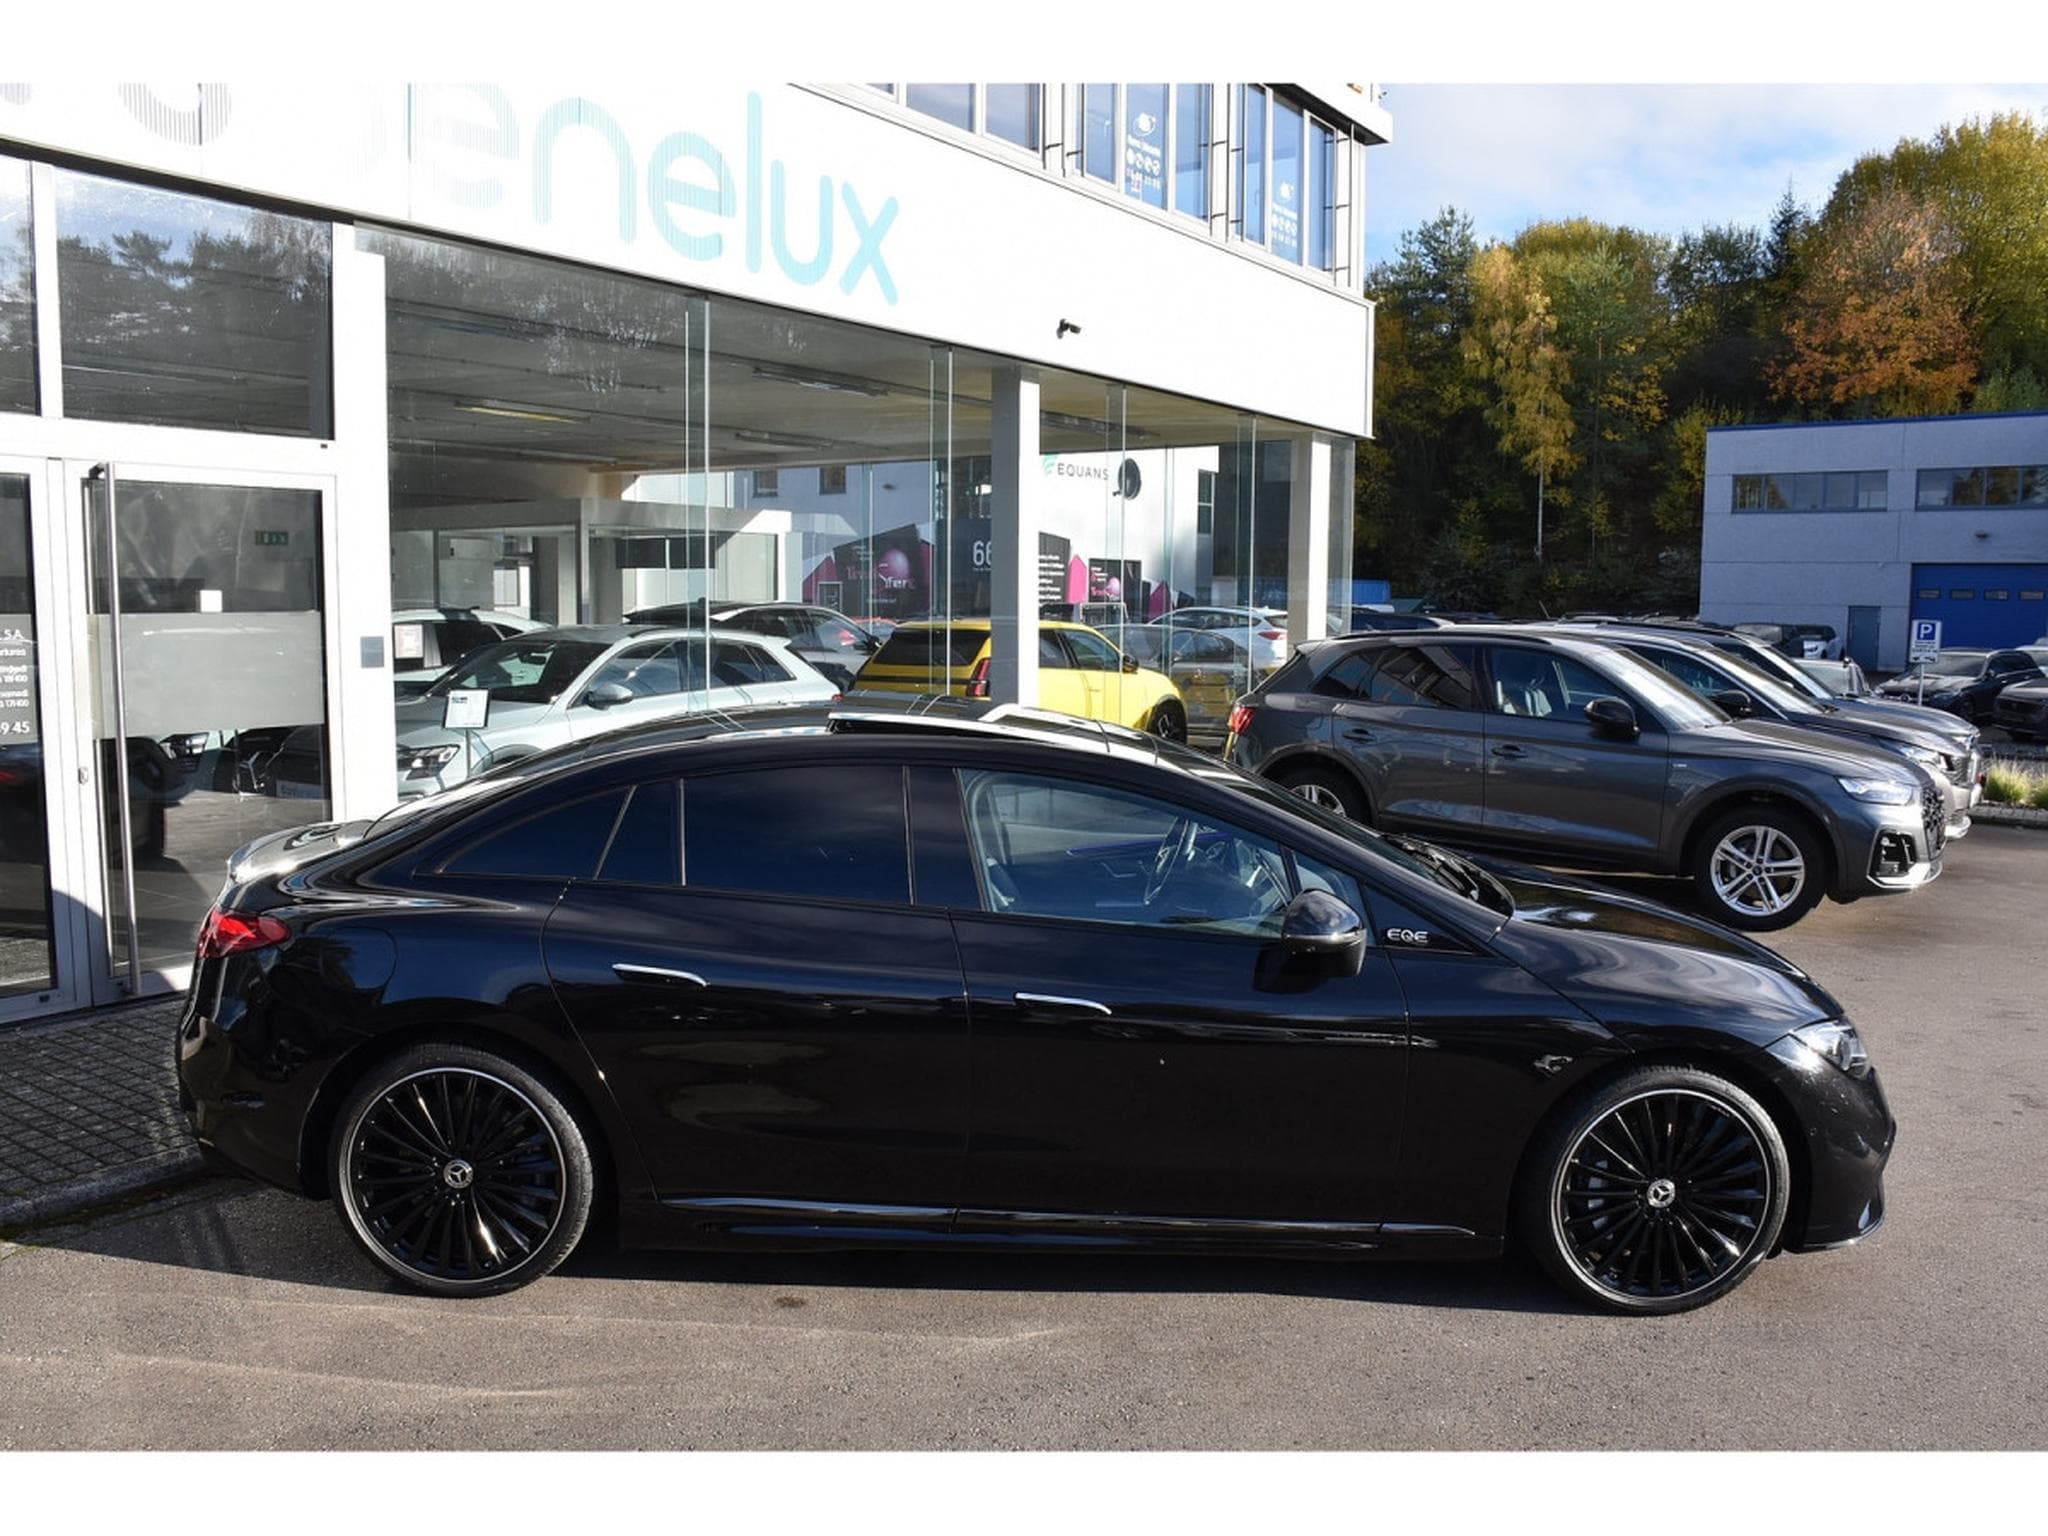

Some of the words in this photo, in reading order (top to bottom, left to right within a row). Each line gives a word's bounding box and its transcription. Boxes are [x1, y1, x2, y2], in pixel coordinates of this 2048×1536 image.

[1057, 463, 1109, 481] EQUANS
[1920, 623, 1933, 639] P
[1387, 928, 1428, 945] EQE
